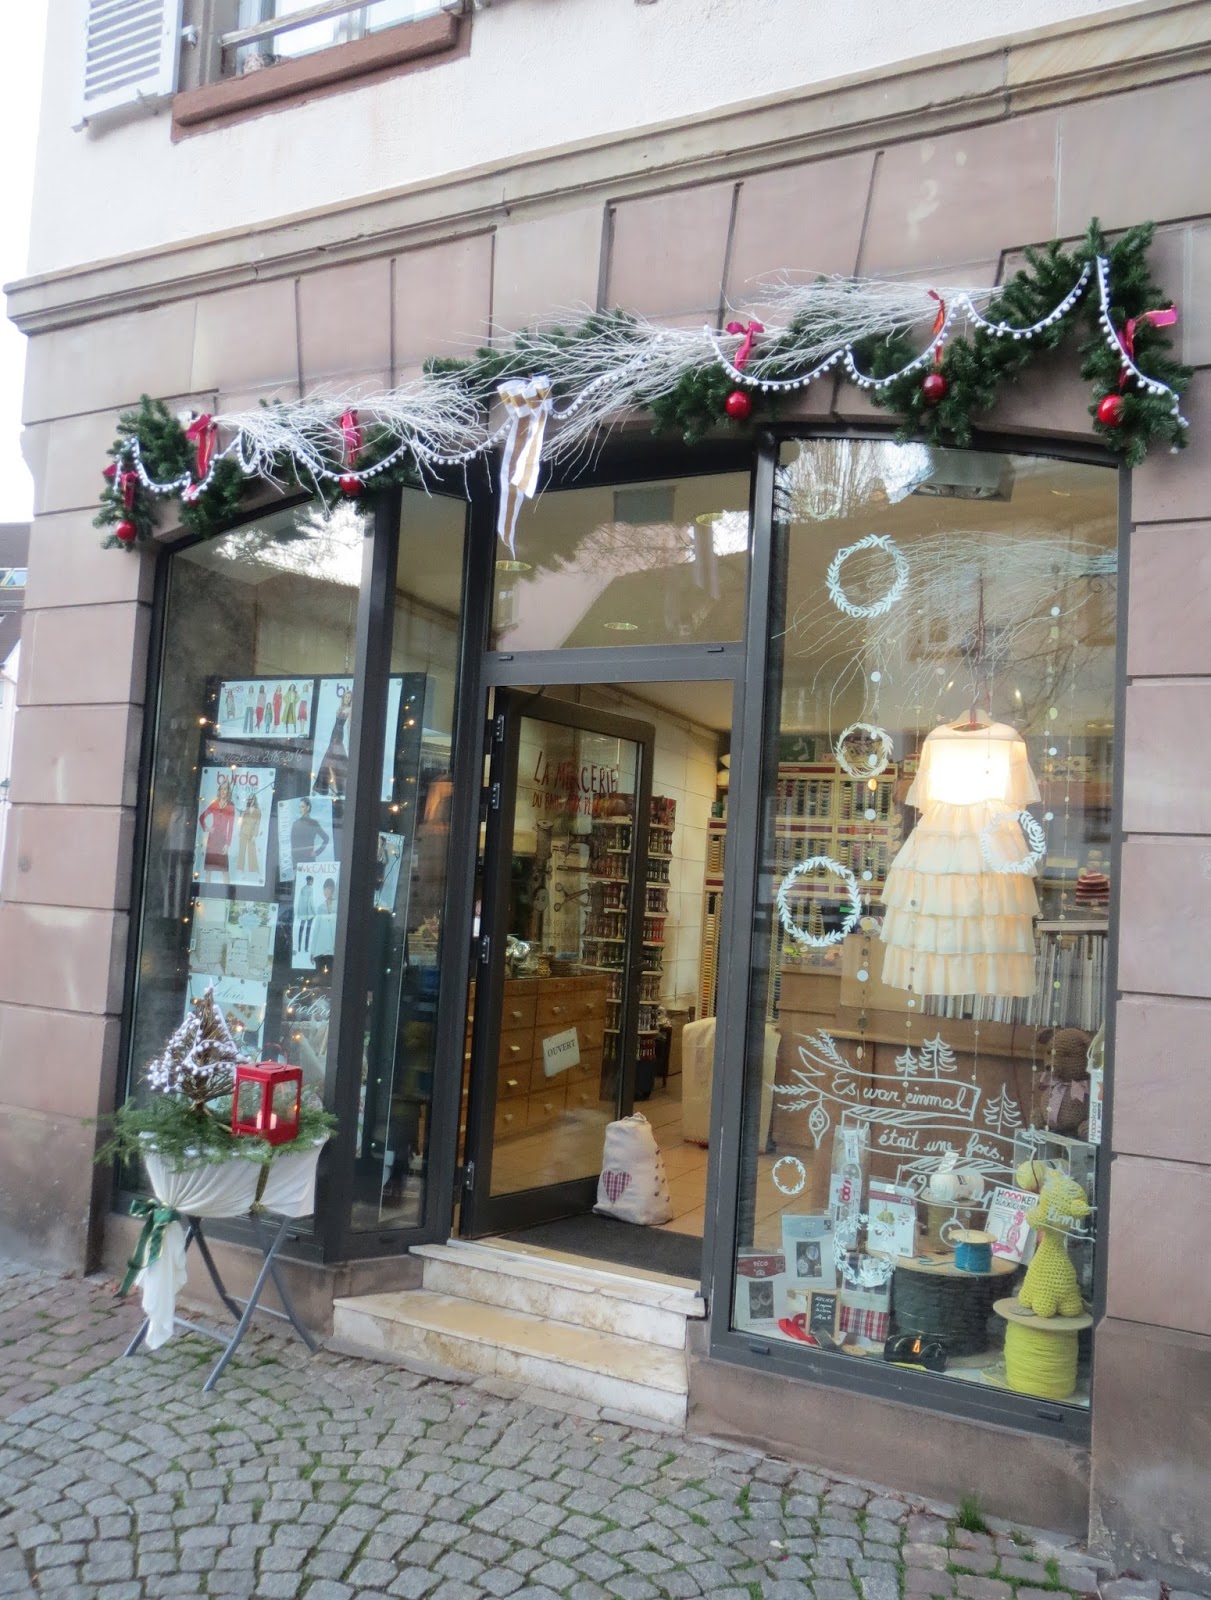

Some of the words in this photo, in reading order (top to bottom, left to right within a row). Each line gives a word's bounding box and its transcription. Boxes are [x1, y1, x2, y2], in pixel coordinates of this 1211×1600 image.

[216, 770, 259, 787] burda
[533, 750, 549, 786] LA
[546, 1038, 576, 1058] OUVERT
[831, 1071, 857, 1096] Es
[862, 1086, 901, 1103] war
[878, 1129, 921, 1152] était
[923, 1140, 963, 1154] une
